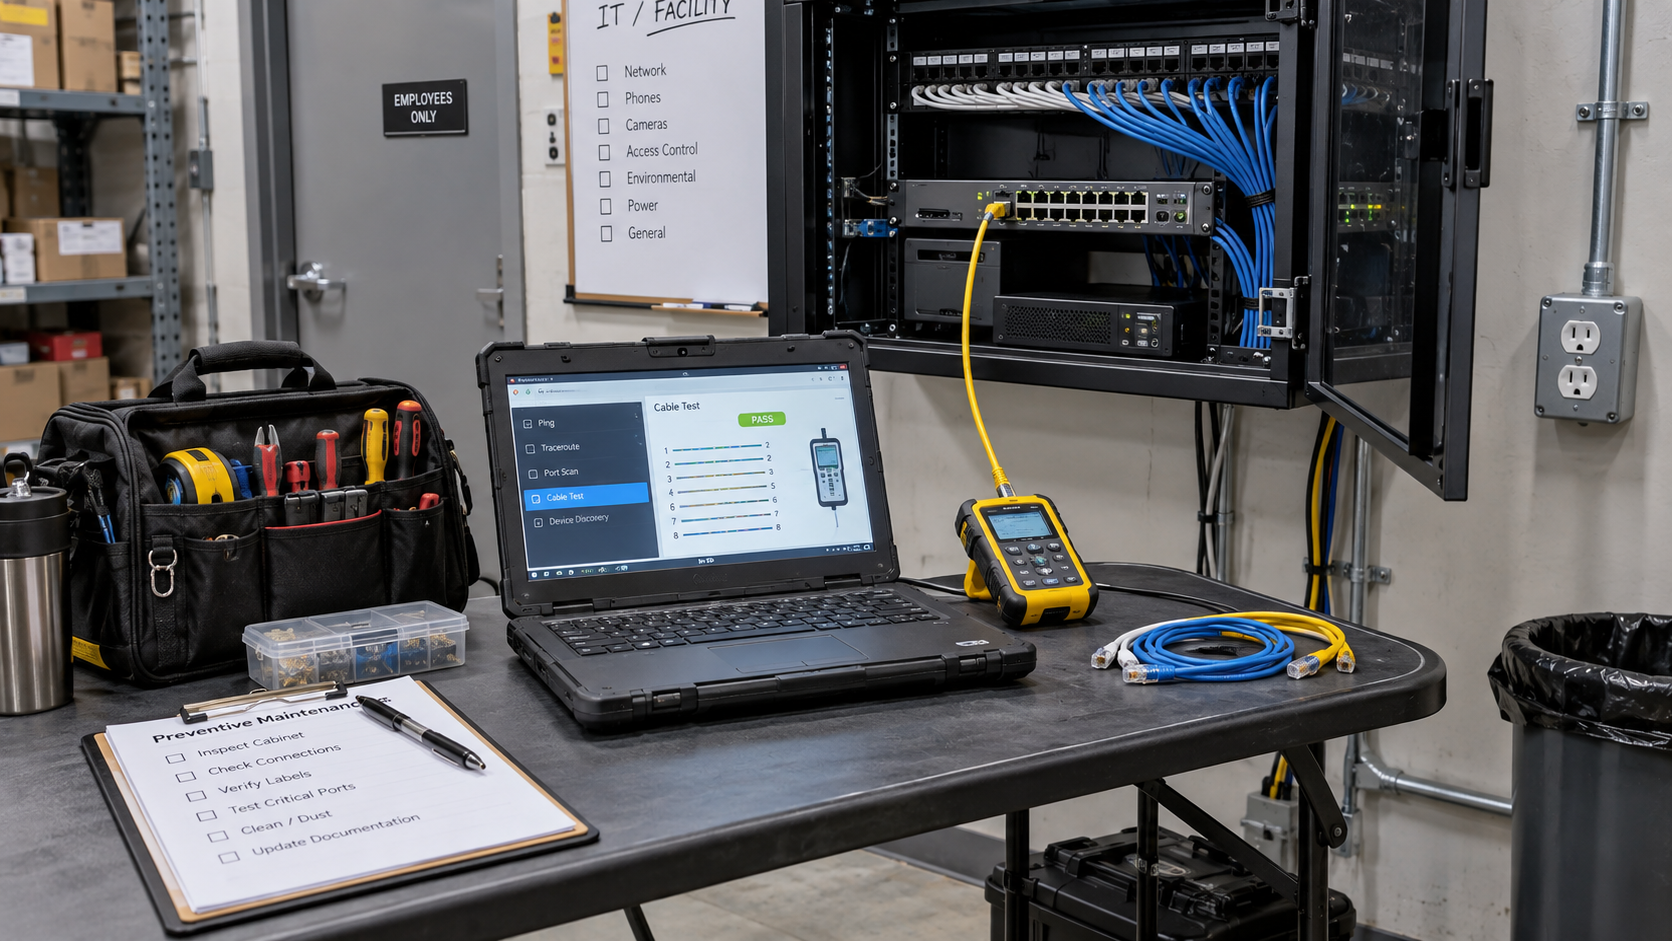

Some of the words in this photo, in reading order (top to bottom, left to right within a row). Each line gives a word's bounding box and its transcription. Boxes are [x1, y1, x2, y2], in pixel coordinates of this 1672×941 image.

[597, 3, 625, 29] IT
[632, 1, 644, 27] /
[624, 63, 667, 78] Network
[394, 91, 453, 107] EMPLOYEES
[625, 91, 661, 104] Phones
[411, 110, 437, 123] ONLY
[625, 118, 668, 131] Cameras
[626, 144, 659, 158] Access
[662, 141, 698, 156] Control
[627, 169, 696, 184] Environmental
[628, 199, 658, 212] Power
[628, 225, 666, 239] General
[654, 402, 679, 412] Cable
[681, 402, 700, 410] Test
[538, 419, 555, 429] Ping
[751, 415, 774, 424] PASS
[541, 443, 580, 452] Traceroute
[544, 469, 560, 477] Port
[561, 468, 579, 476] Scan
[667, 475, 672, 483] 3
[547, 493, 567, 502] Cable
[569, 492, 584, 500] Test
[670, 503, 675, 511] 6
[152, 719, 253, 743] Preventive
[256, 701, 361, 725] Maintenanc
[198, 742, 250, 758] Inspect
[252, 731, 305, 747] Cabinet
[208, 760, 253, 776] Check
[255, 743, 342, 767] Connections
[218, 779, 262, 794] Verify
[265, 770, 312, 785] Labels
[228, 801, 262, 815] Test
[264, 791, 315, 807] Critical
[317, 782, 356, 796] Ports
[241, 819, 284, 835] Clean
[288, 817, 293, 826] /
[297, 809, 333, 824] Dust
[251, 838, 307, 856] Update
[310, 813, 421, 843] Documentation
